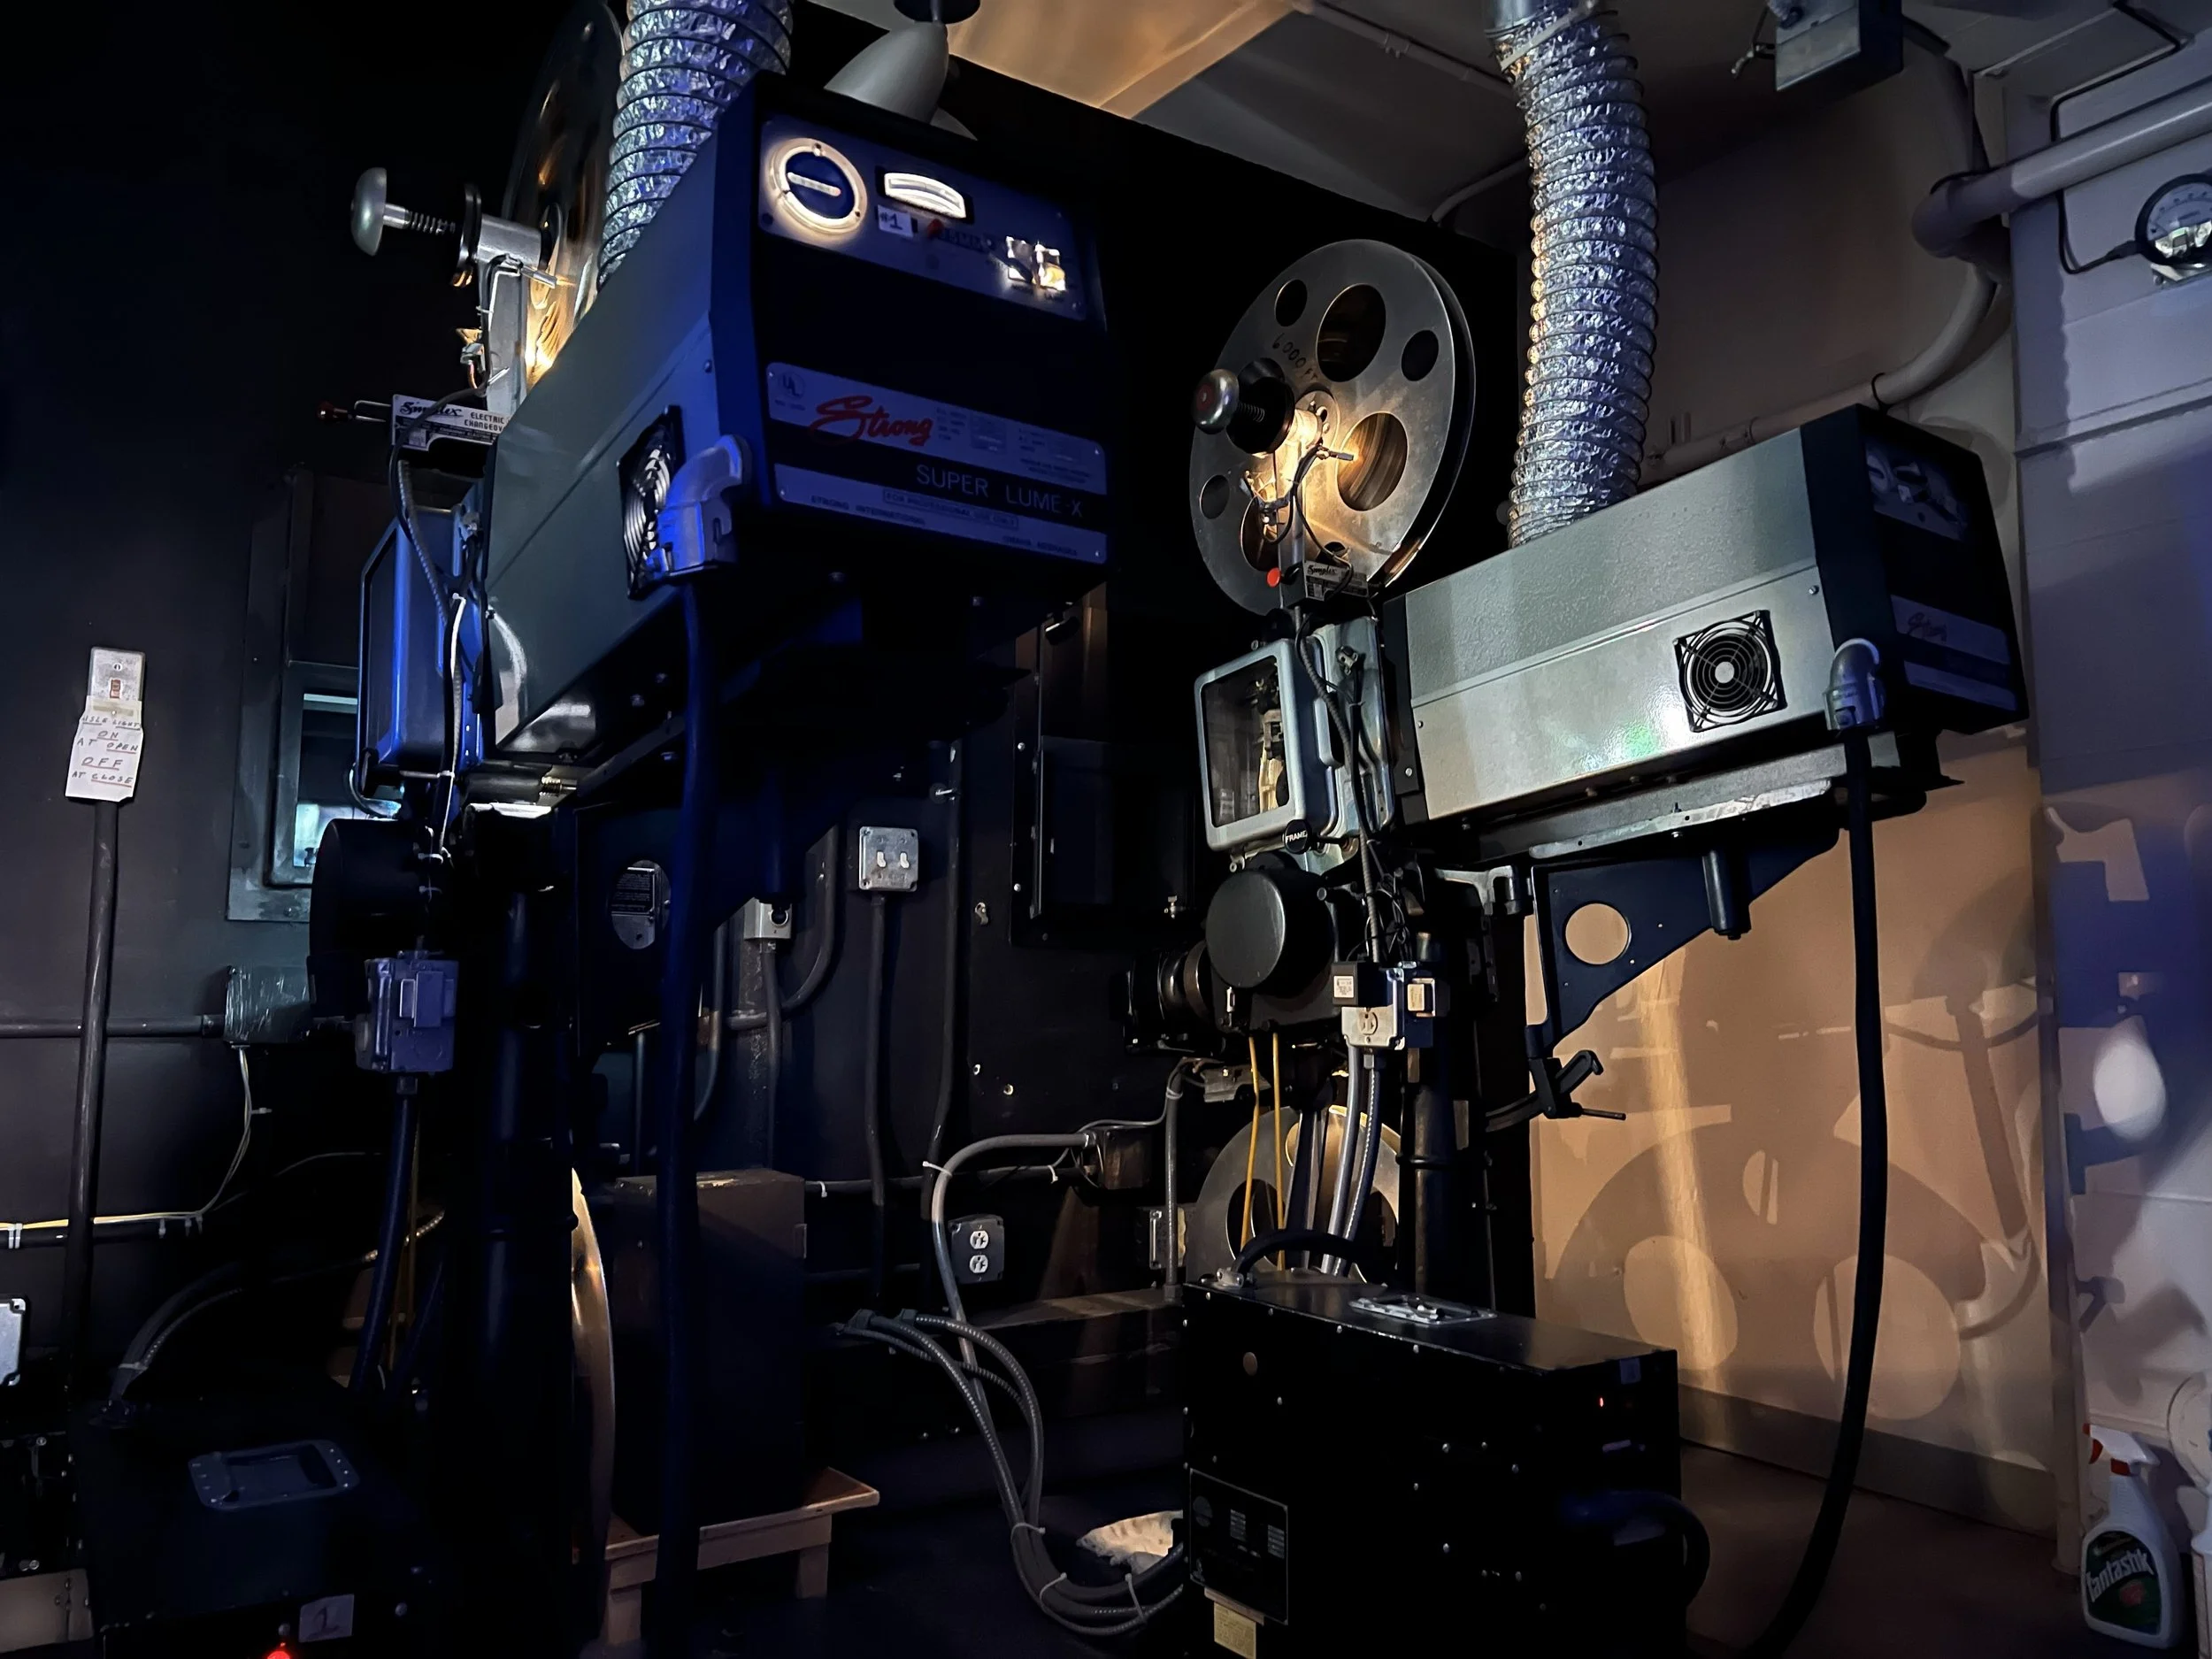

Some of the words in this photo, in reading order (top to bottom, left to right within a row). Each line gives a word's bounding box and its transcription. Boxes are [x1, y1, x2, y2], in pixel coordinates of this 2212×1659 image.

[1272, 332, 1307, 368] 6000
[471, 411, 505, 424] ELECTRIC
[807, 395, 933, 447] Strong
[916, 464, 989, 498] SUPER
[106, 742, 139, 751] OPEN
[81, 757, 124, 767] OFF
[91, 773, 134, 784] CLOSE
[1285, 830, 1309, 844] FRAME
